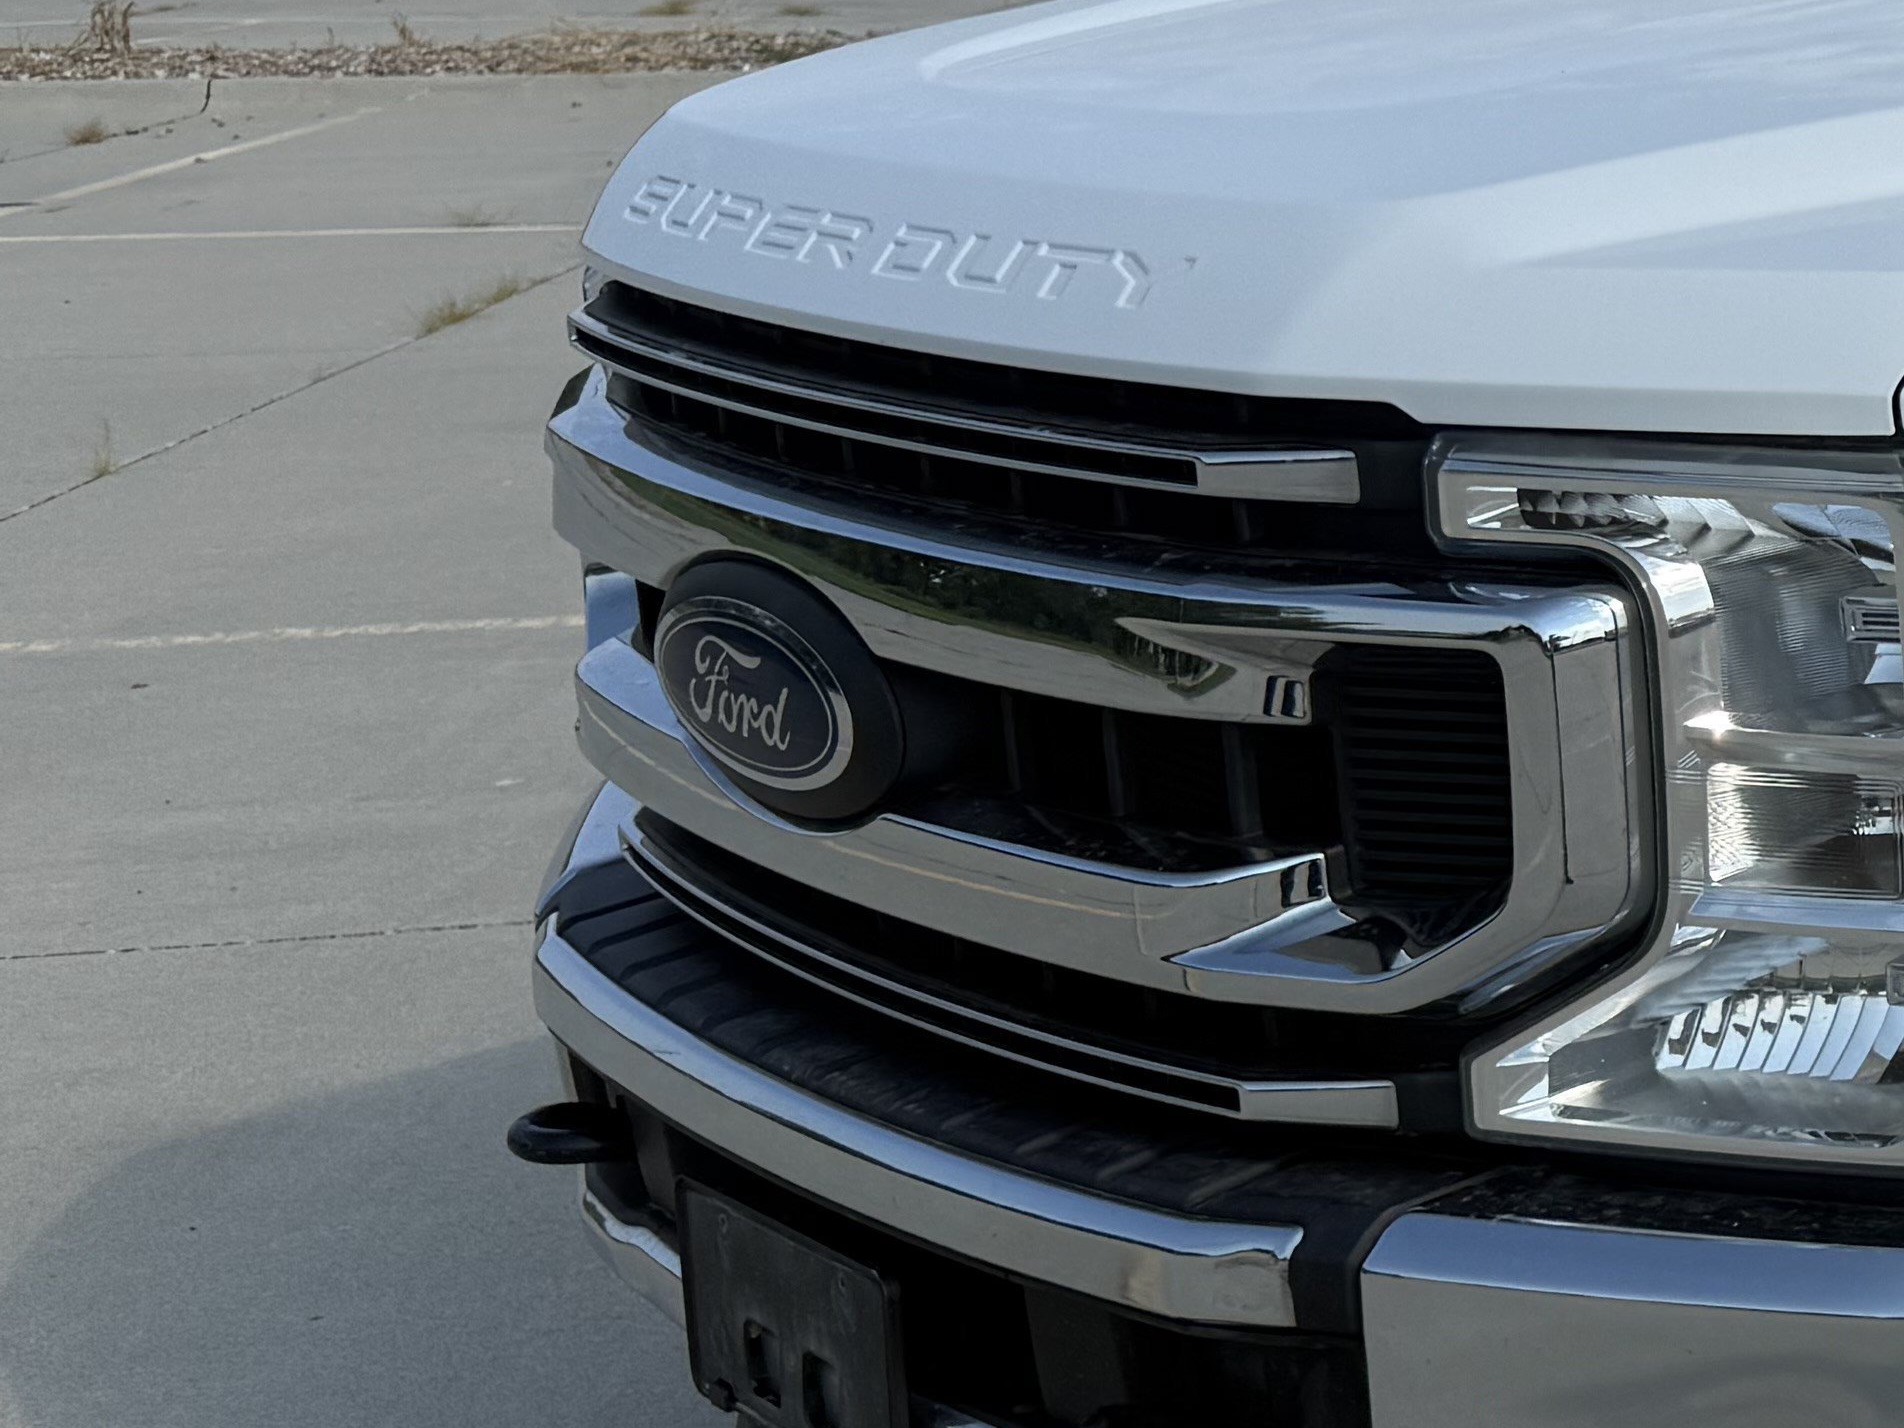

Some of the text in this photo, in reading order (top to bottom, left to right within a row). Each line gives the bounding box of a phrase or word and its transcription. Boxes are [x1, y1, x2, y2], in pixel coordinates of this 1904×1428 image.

[623, 175, 1196, 310] SUPER DUTY
[689, 634, 791, 751] Ford
